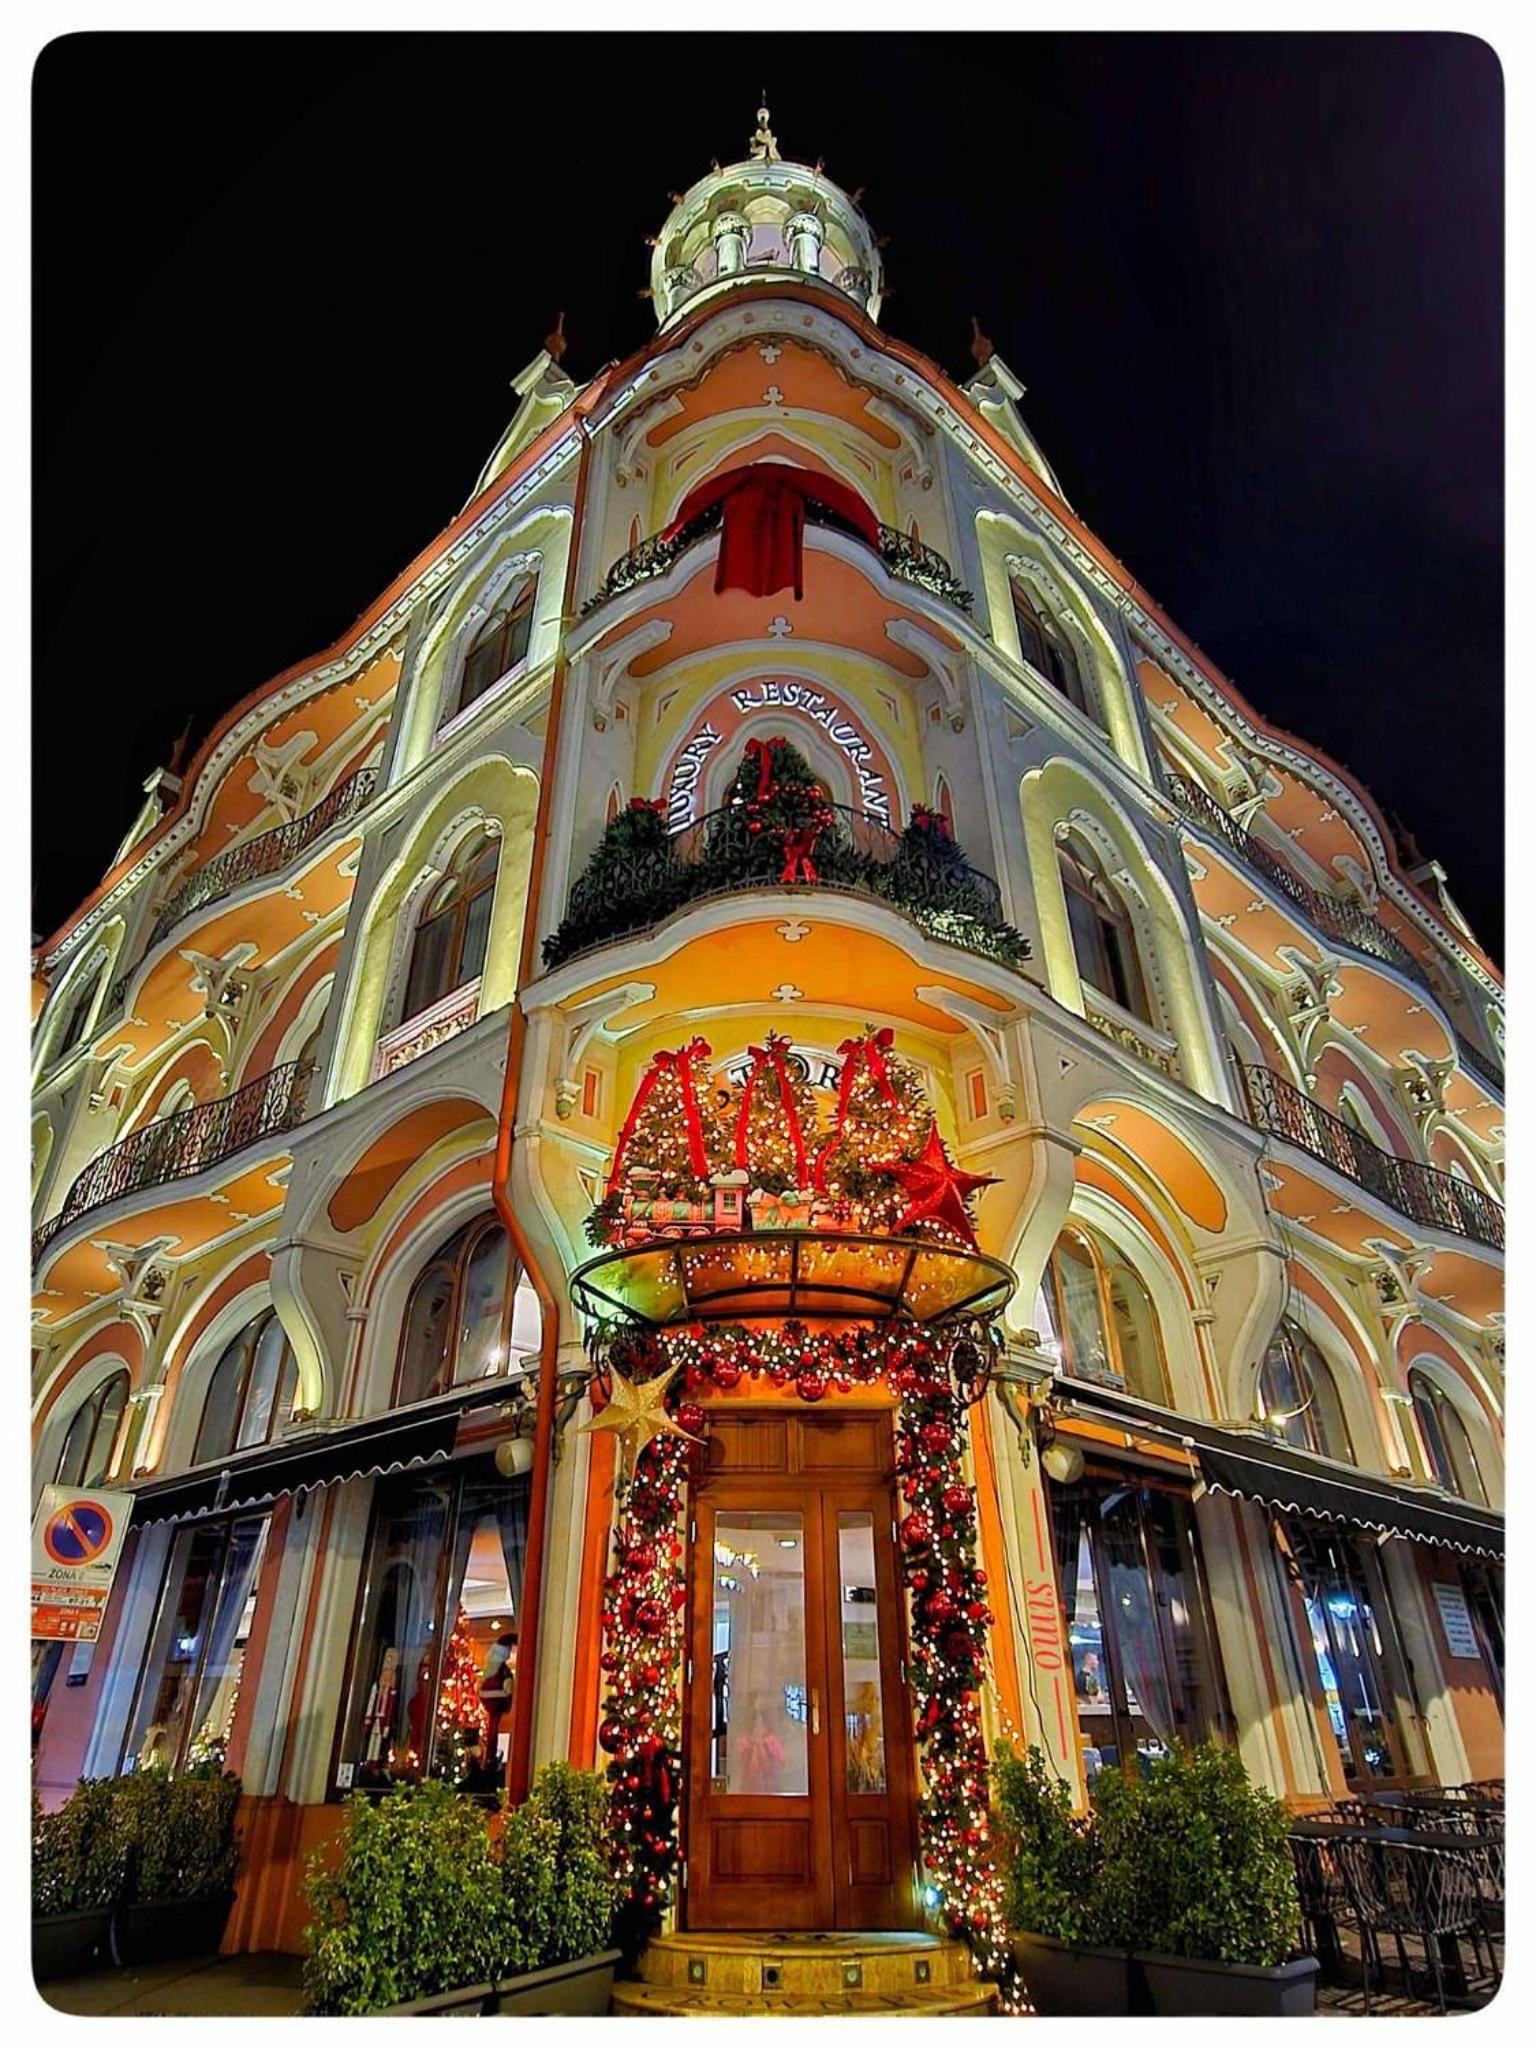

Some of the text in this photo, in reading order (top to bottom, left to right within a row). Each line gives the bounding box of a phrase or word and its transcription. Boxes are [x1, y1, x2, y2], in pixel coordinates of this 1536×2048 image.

[667, 681, 890, 836] LUXURY RESTAURANT
[48, 1568, 76, 1580] ZONA
